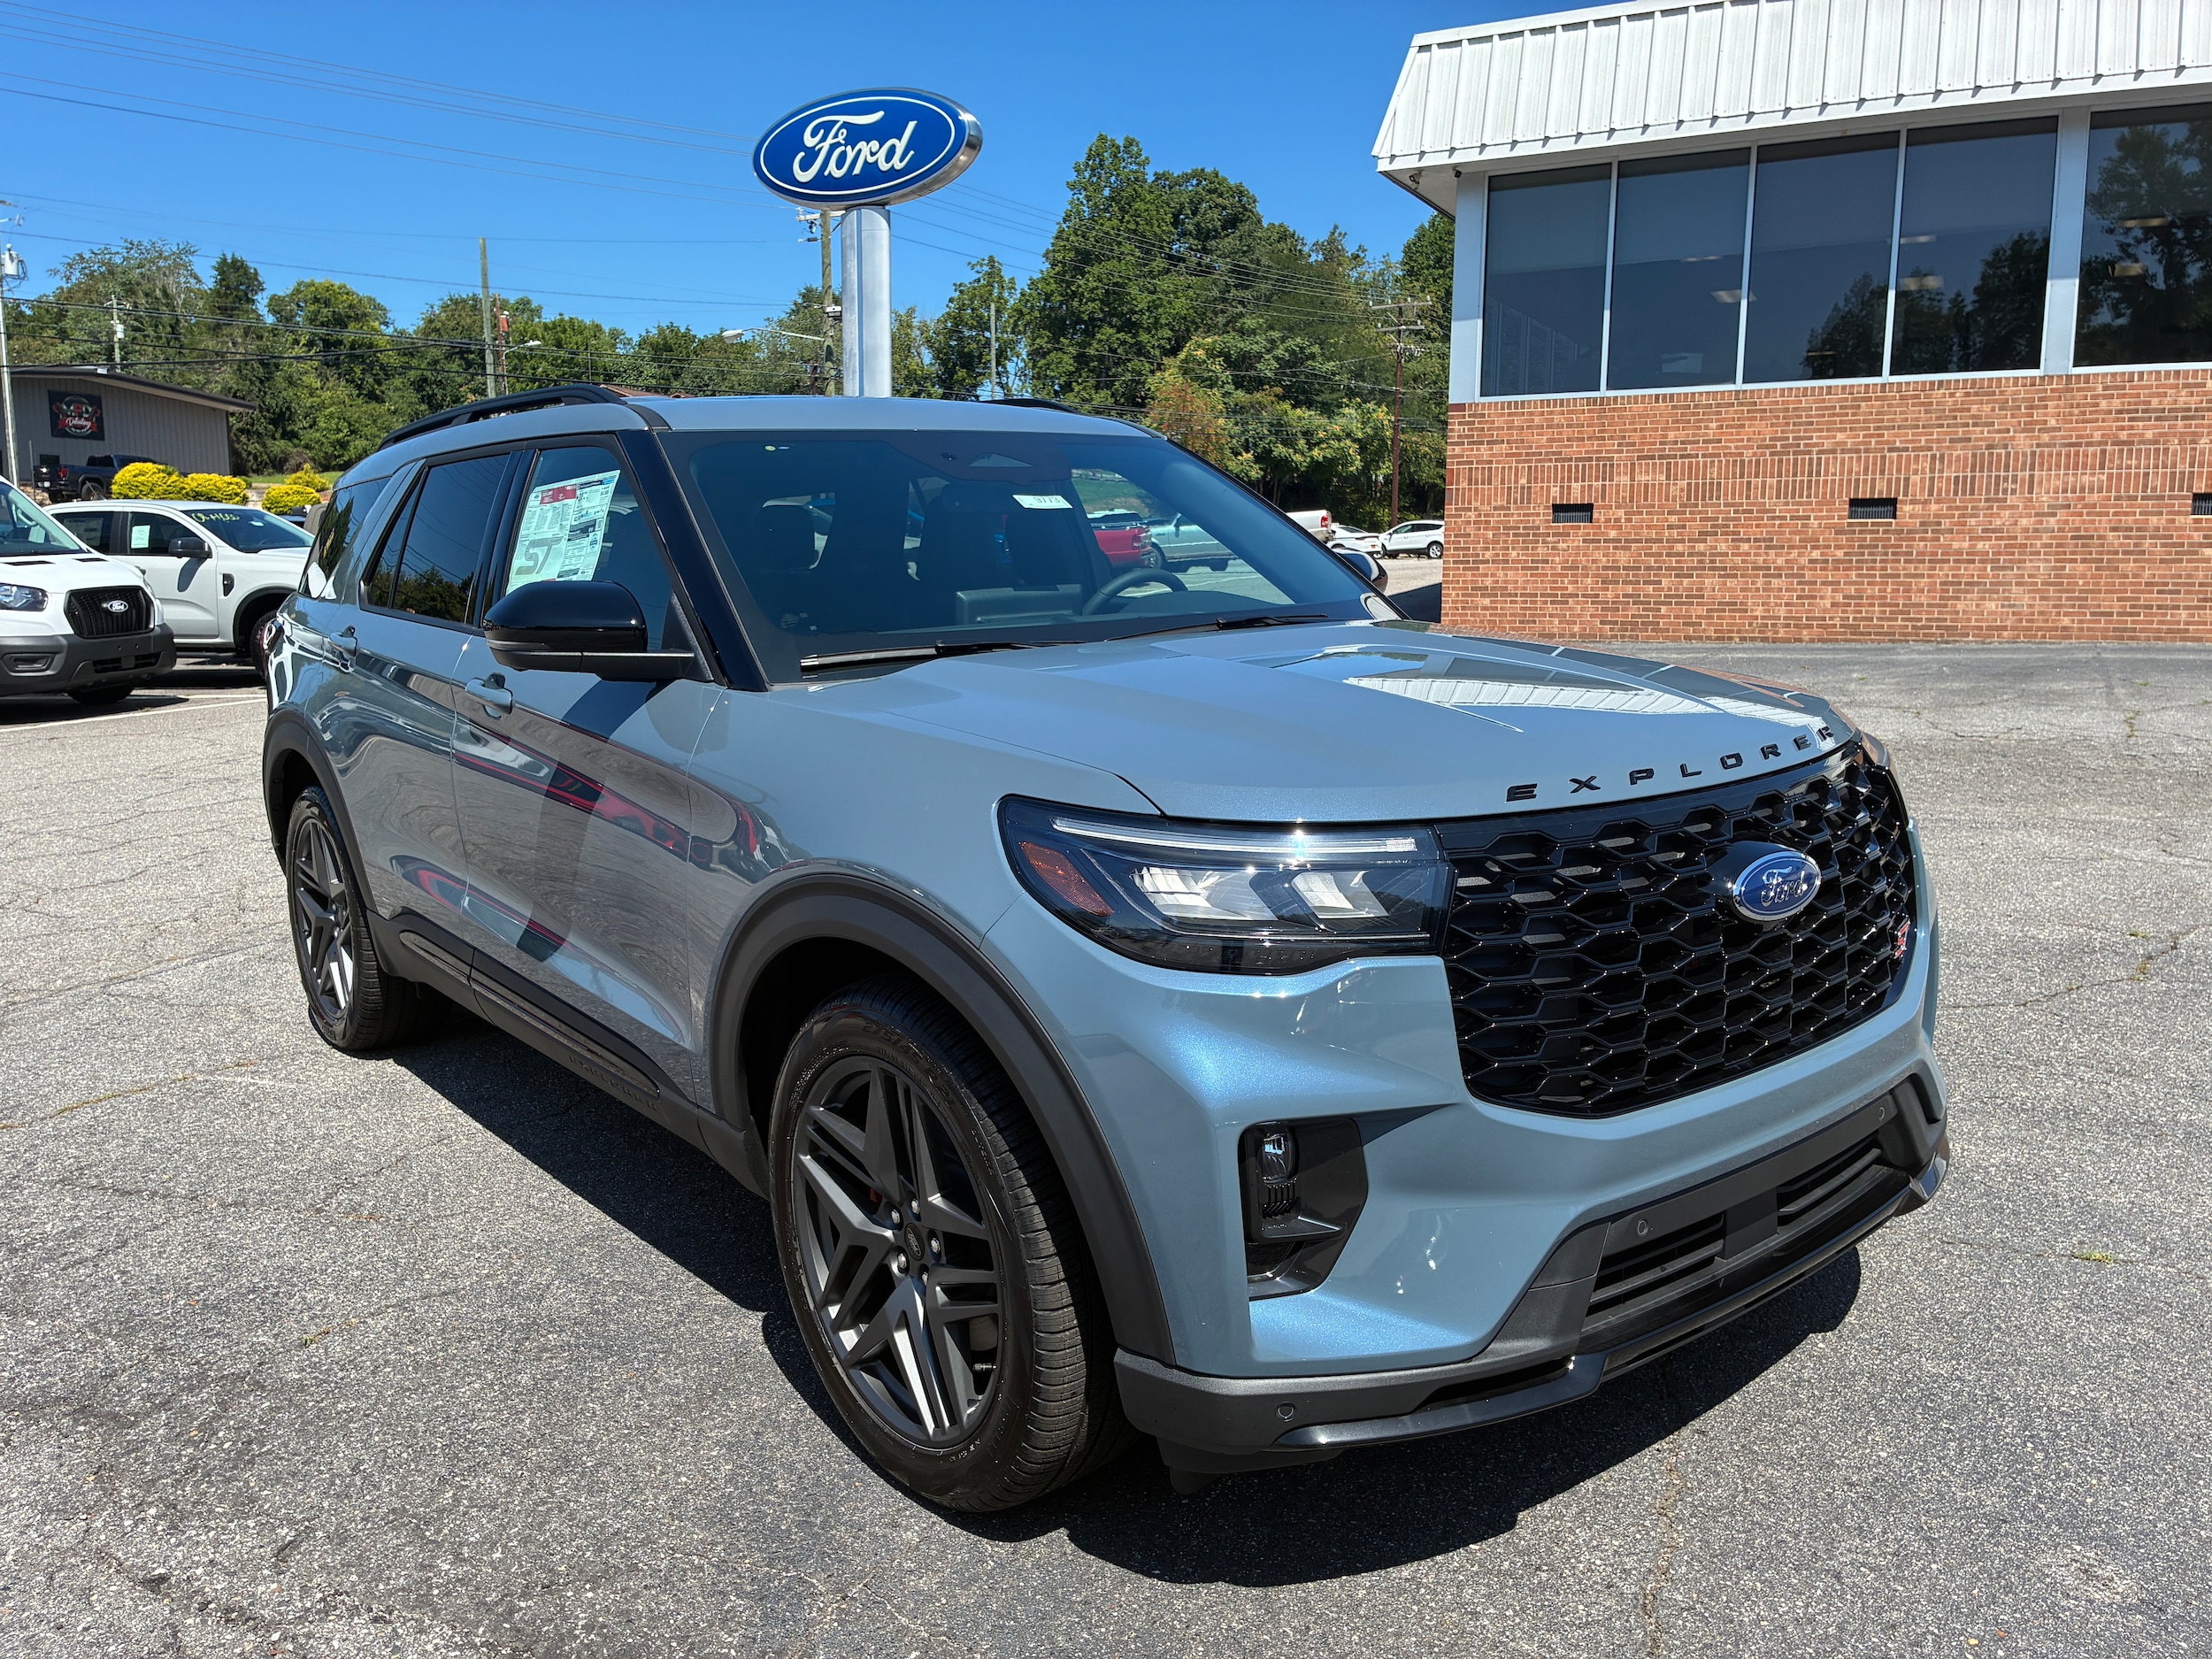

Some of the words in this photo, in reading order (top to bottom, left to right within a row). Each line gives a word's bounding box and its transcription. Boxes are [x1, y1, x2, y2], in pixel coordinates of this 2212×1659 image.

[792, 111, 918, 183] Ford
[1505, 726, 1834, 803] EXPLORER
[1760, 865, 1809, 907] Ford
